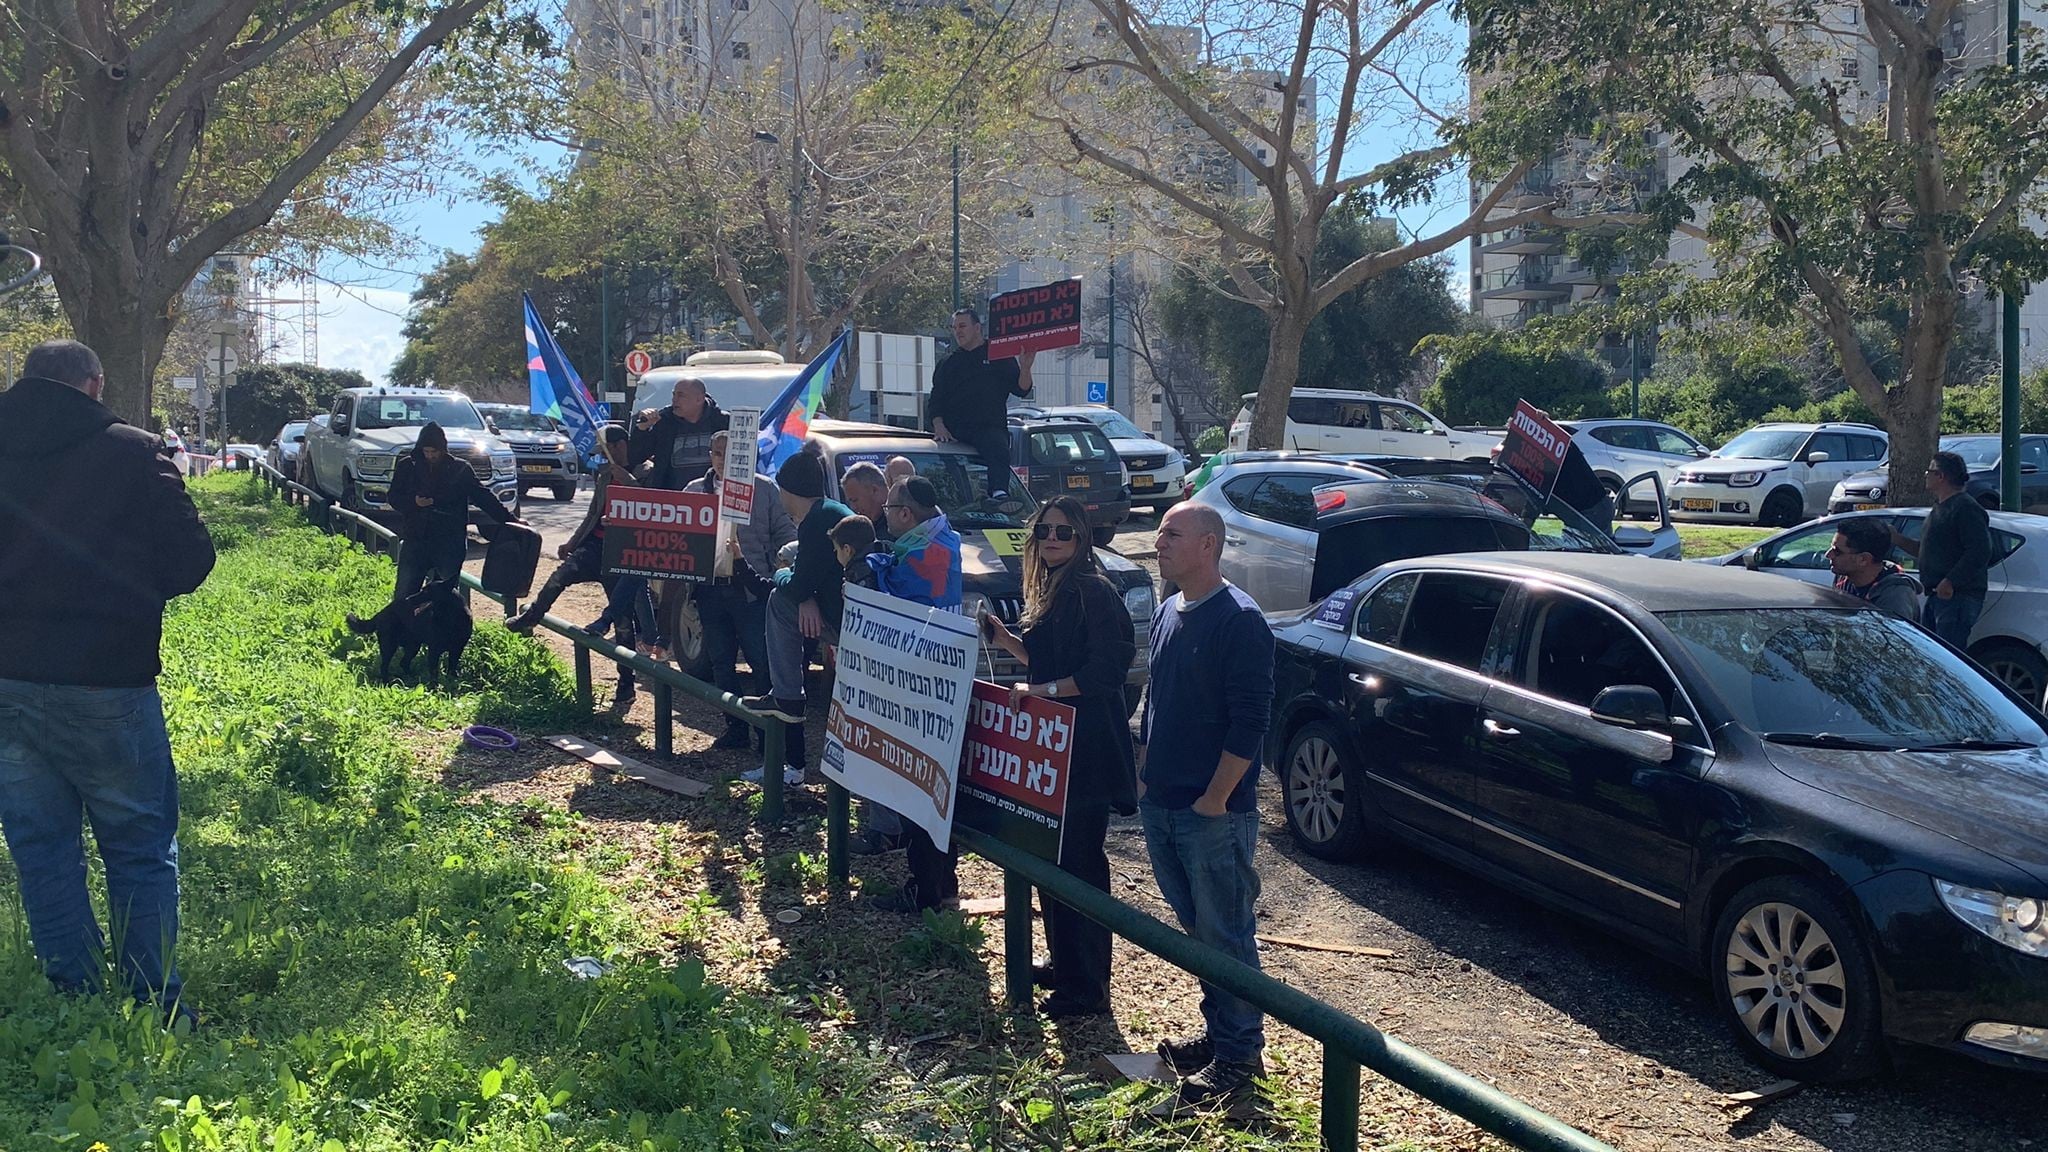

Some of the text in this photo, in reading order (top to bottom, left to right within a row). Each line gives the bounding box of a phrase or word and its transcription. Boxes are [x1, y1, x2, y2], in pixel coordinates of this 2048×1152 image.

[1056, 280, 1079, 299] לא
[1050, 303, 1074, 320] לא
[1513, 410, 1555, 451] הכנסות
[609, 499, 714, 527] 0 הכנסות
[634, 529, 688, 551] 100%
[620, 548, 695, 571] הוצאות
[862, 619, 901, 649] מאמינים
[900, 629, 916, 654] לא
[914, 637, 966, 670] העצמאים
[863, 656, 895, 686] סינגפור
[897, 668, 932, 698] הבטיח
[858, 686, 902, 723] העצמאים
[904, 706, 920, 730] את
[855, 724, 870, 750] לא
[1036, 715, 1069, 753] לא
[881, 739, 913, 774] פרנסה
[914, 756, 928, 781] לא
[1025, 758, 1058, 797] לא
[1047, 818, 1059, 829] ענף
